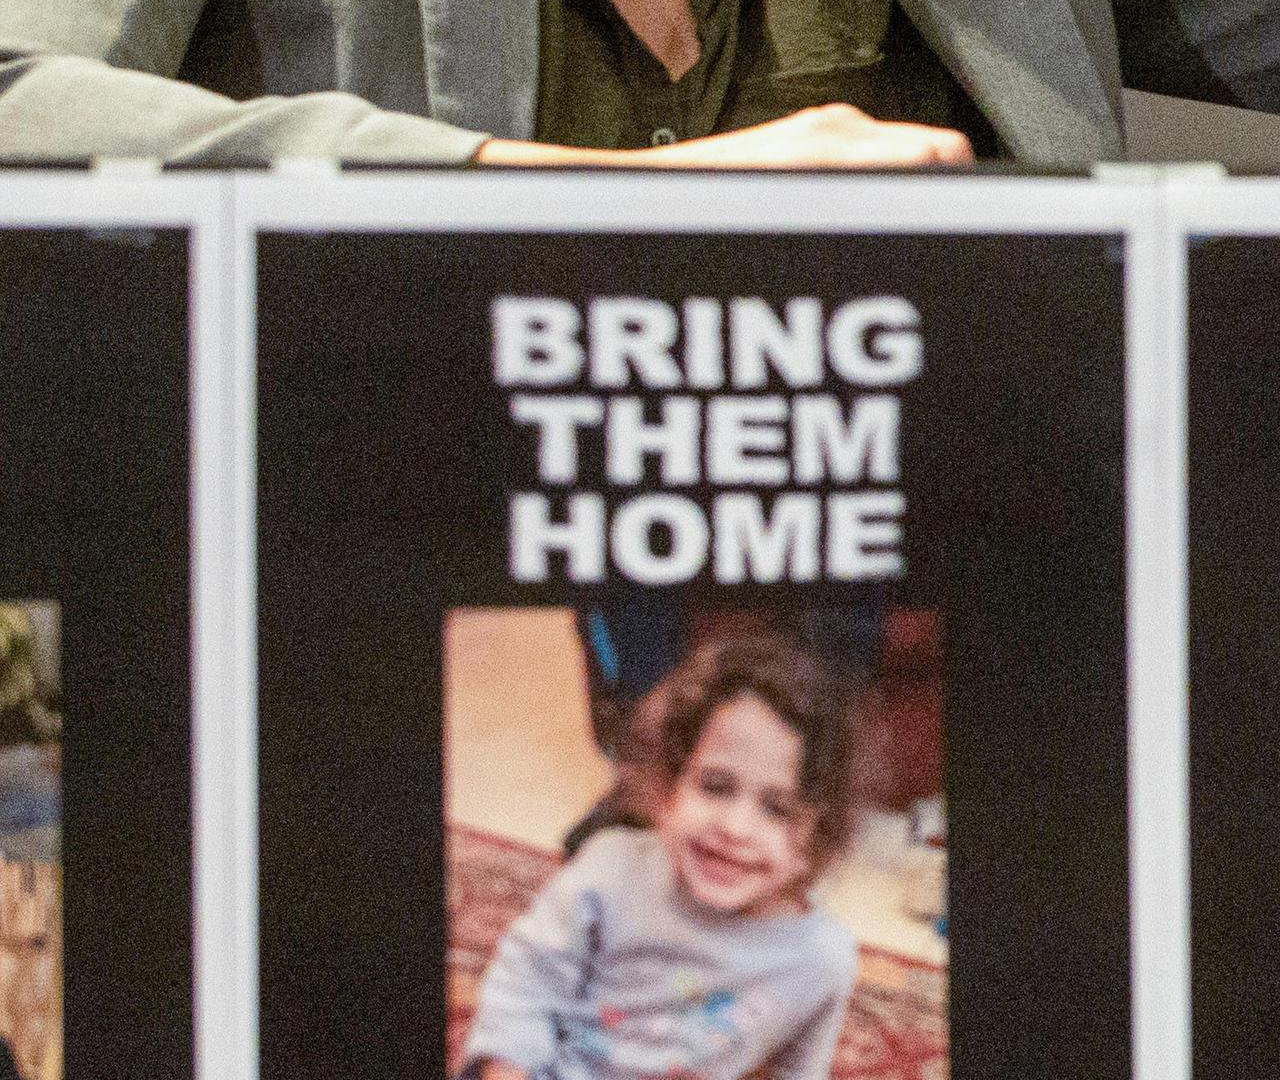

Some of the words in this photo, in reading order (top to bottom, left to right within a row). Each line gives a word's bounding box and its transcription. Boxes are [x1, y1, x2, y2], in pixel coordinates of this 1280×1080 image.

[492, 295, 923, 389] BRING
[511, 395, 900, 485] THEM
[510, 491, 905, 585] HOME
